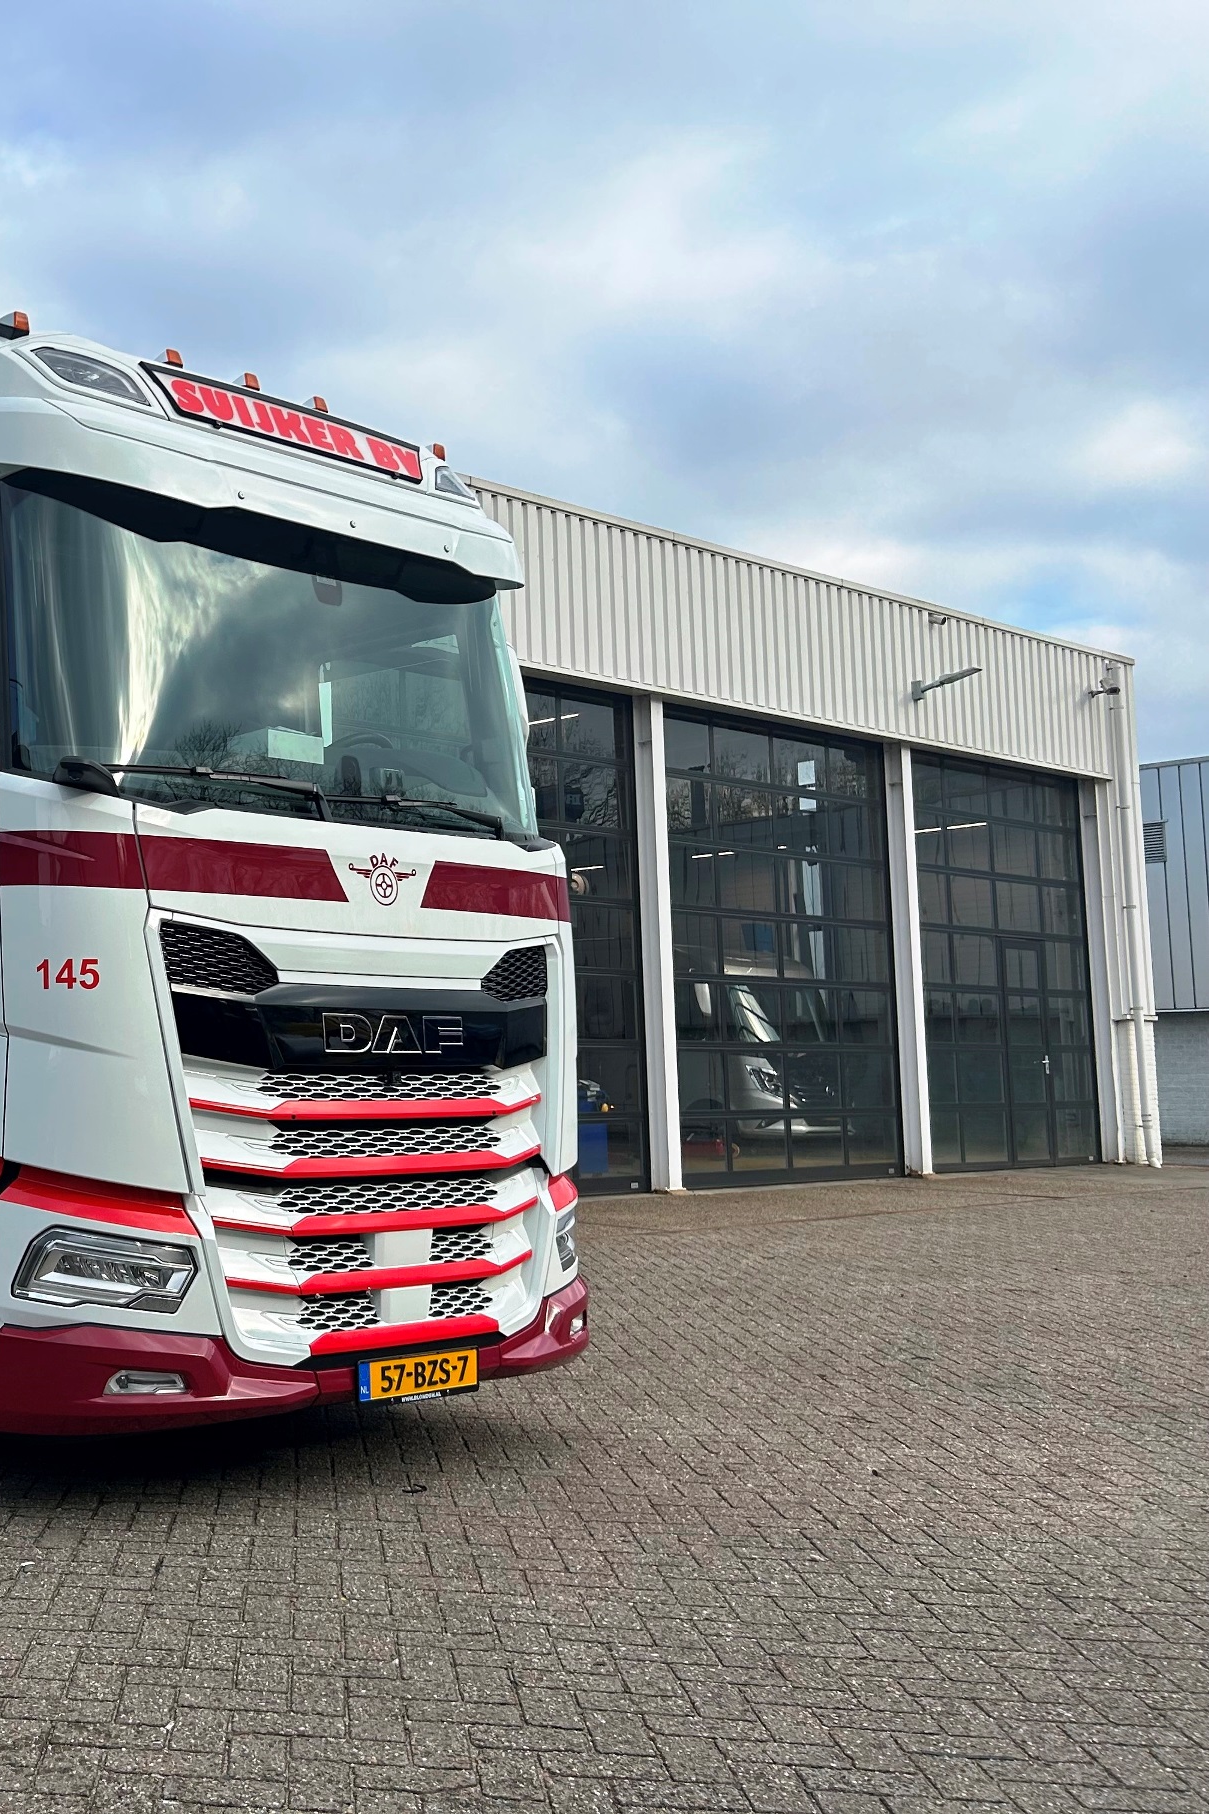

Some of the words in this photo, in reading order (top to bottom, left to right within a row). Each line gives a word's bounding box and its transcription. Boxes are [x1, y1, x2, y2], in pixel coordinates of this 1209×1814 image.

[170, 377, 365, 461] SUIJKER
[366, 435, 421, 481] BV
[369, 852, 399, 868] DAF
[36, 958, 100, 990] 145
[322, 1012, 464, 1054] DAF
[360, 1385, 369, 1395] NL
[380, 1355, 469, 1393] 57-BZS-7
